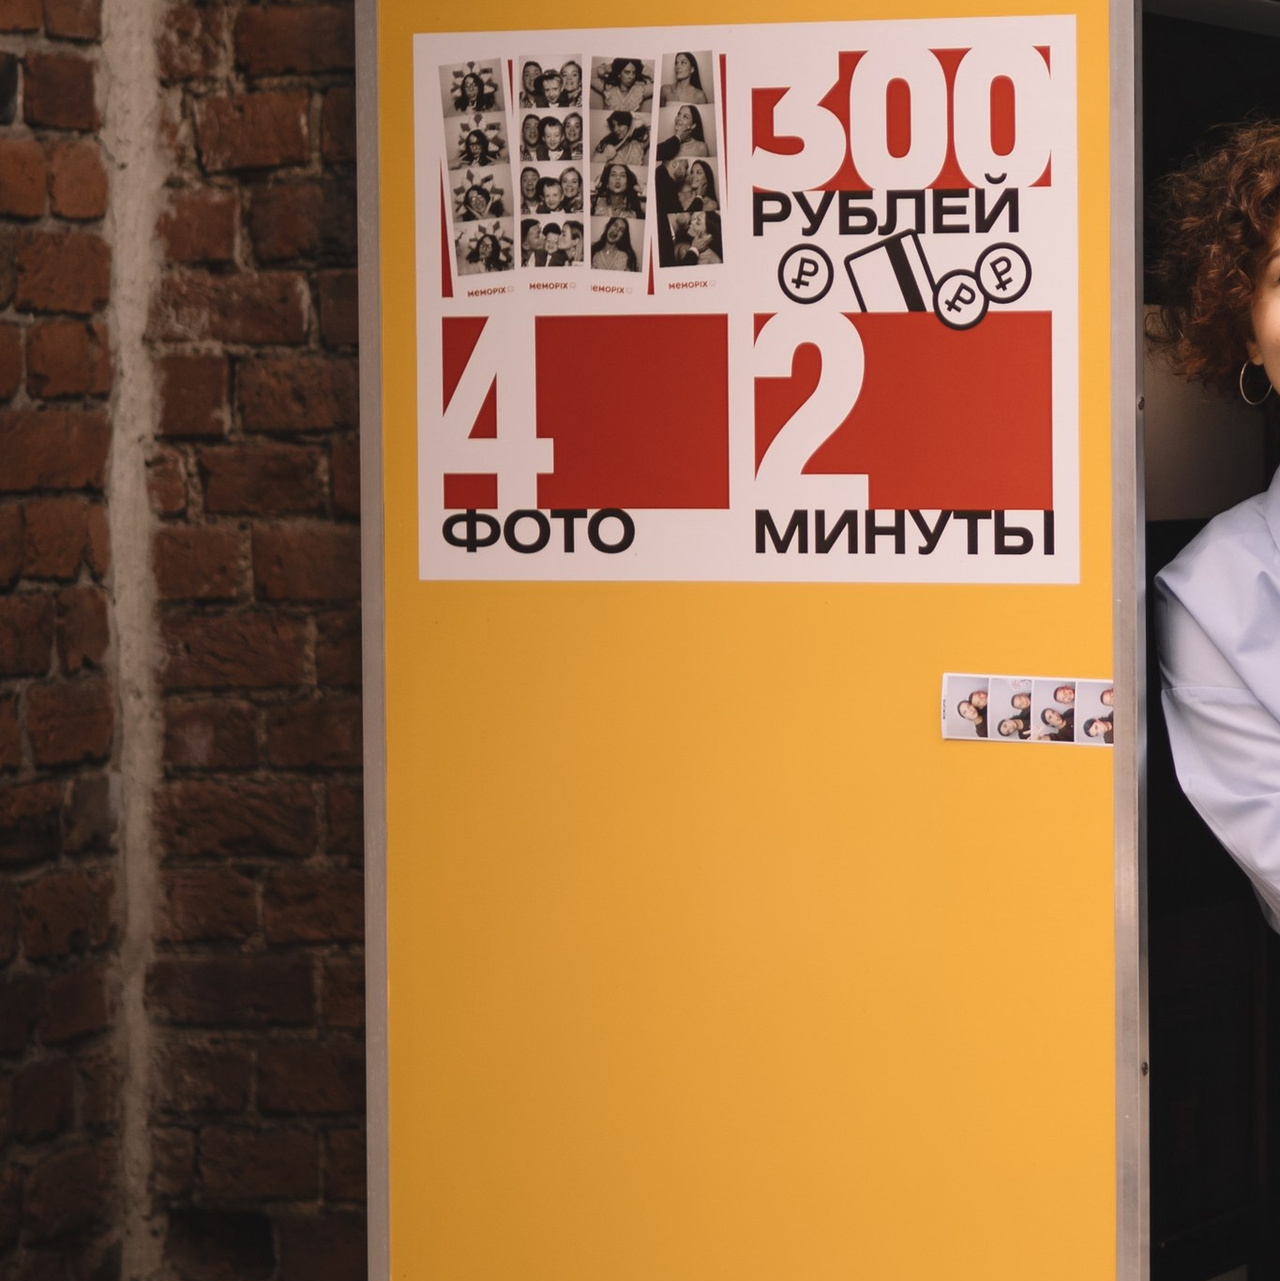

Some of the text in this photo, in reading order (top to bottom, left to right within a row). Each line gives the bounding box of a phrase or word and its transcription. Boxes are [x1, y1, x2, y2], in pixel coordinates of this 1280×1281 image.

[751, 46, 1052, 192] 300
[752, 172, 1020, 236] РУБЛЕЙ
[442, 315, 554, 509] 4
[754, 311, 869, 510] 2
[442, 508, 636, 555] ФОТО
[754, 508, 1056, 556] МИНУТЫ
